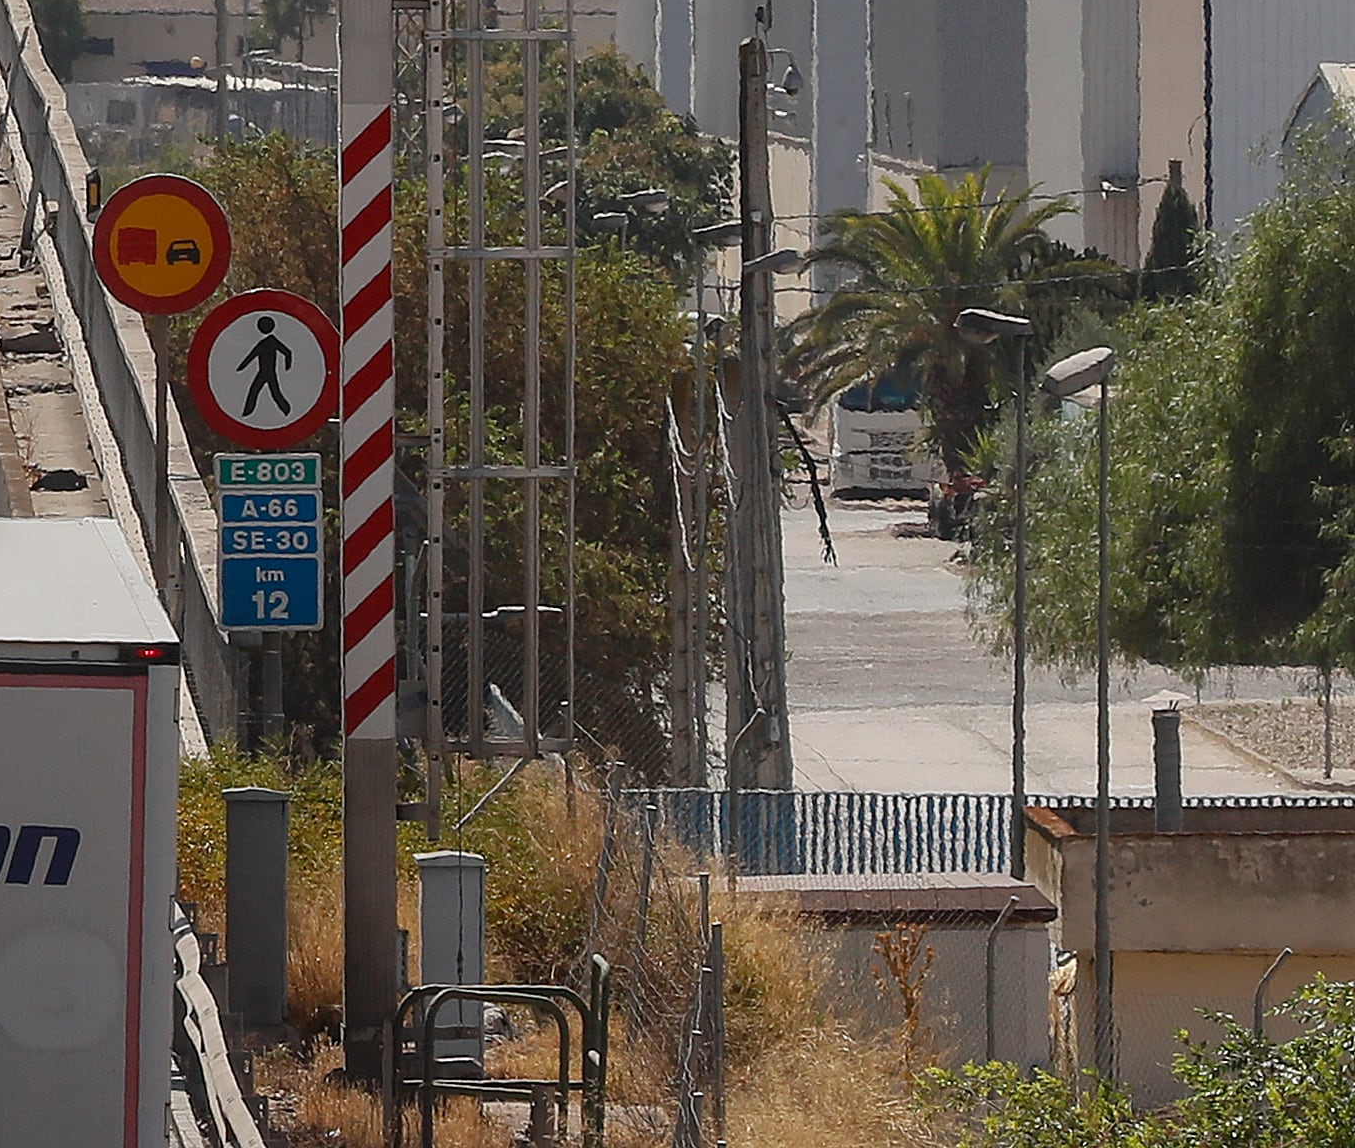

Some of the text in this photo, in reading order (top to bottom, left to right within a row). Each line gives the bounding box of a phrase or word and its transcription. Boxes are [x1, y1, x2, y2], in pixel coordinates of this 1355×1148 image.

[230, 462, 306, 482] E-803
[241, 499, 299, 518] A-66
[232, 530, 310, 550] SE-30
[255, 566, 285, 583] km
[252, 590, 290, 620] 12
